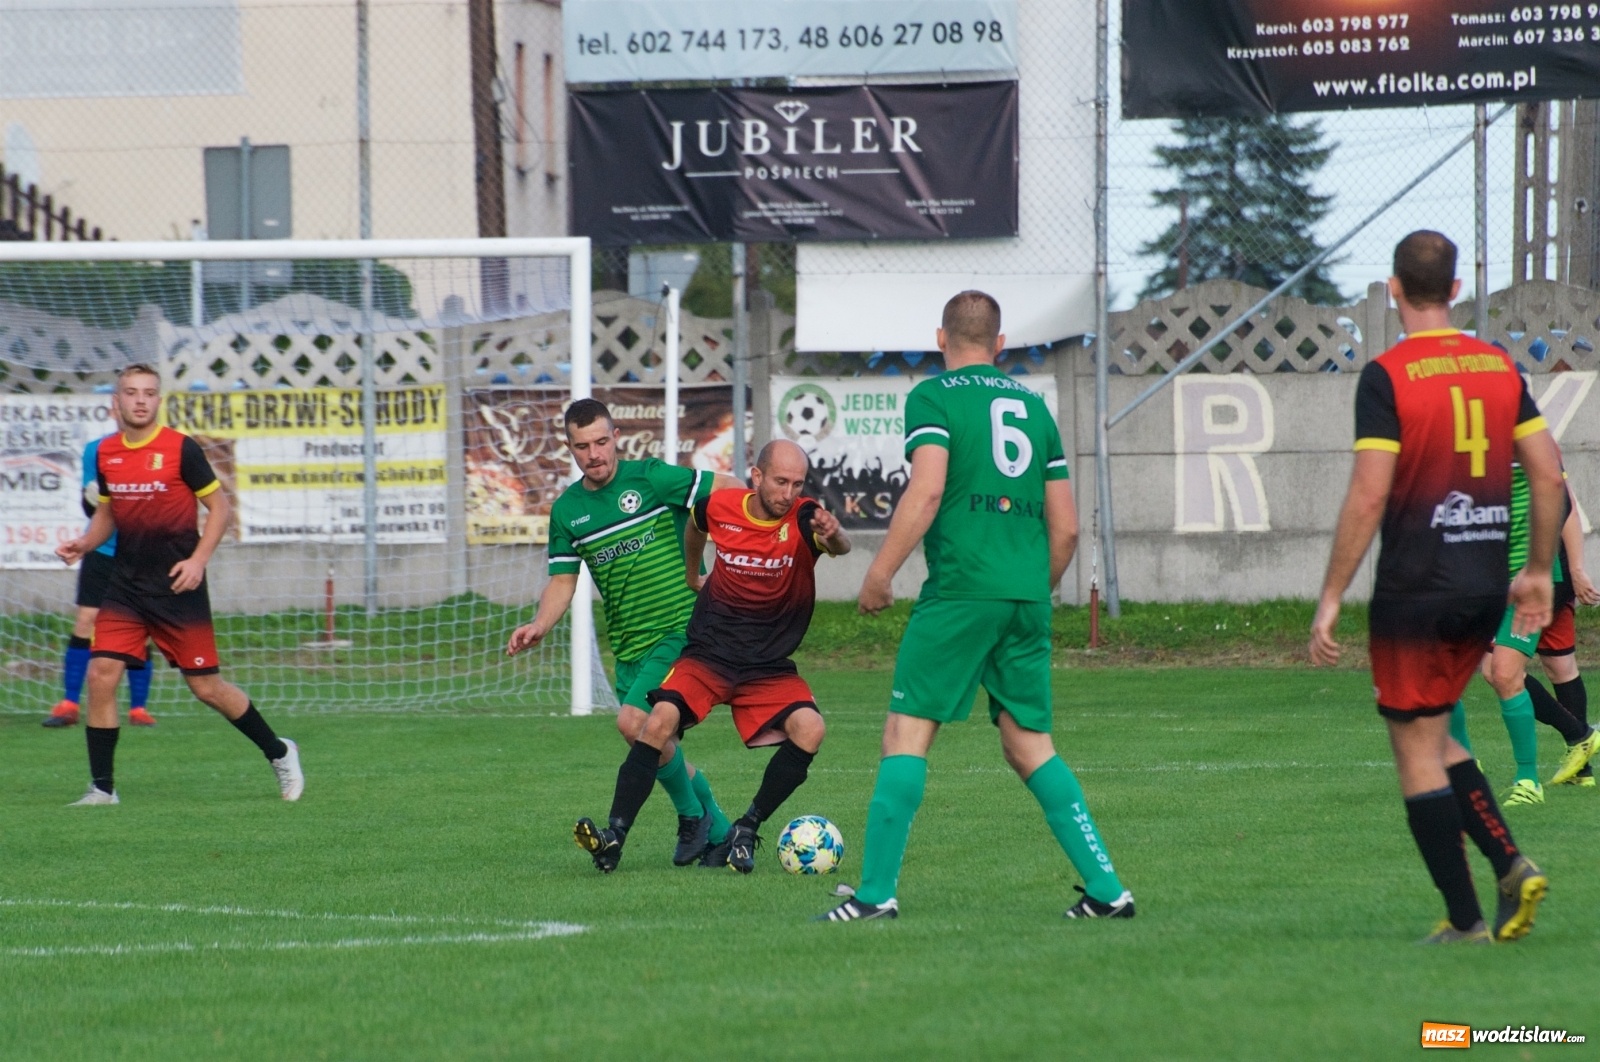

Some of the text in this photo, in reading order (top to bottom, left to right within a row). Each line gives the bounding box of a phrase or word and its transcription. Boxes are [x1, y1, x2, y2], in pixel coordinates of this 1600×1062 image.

[1256, 14, 1409, 35] Karol: 603 798 977
[1451, 3, 1600, 26] Tomasz: 603 798 9
[578, 21, 1003, 55] tel. 602 744 173, 48 606 27 08 98
[1227, 35, 1410, 60] Krzysztof: 605 083 762
[1458, 33, 1509, 47] Marcin:
[1513, 28, 1546, 45] 607
[1552, 26, 1585, 43] 336
[1313, 66, 1537, 97] www.fiolka.com.pl
[744, 164, 839, 180] POŚPIECH
[941, 375, 970, 388] LKS
[841, 393, 897, 411] JEDEN
[989, 397, 1033, 478] 6
[1450, 386, 1490, 478] 4
